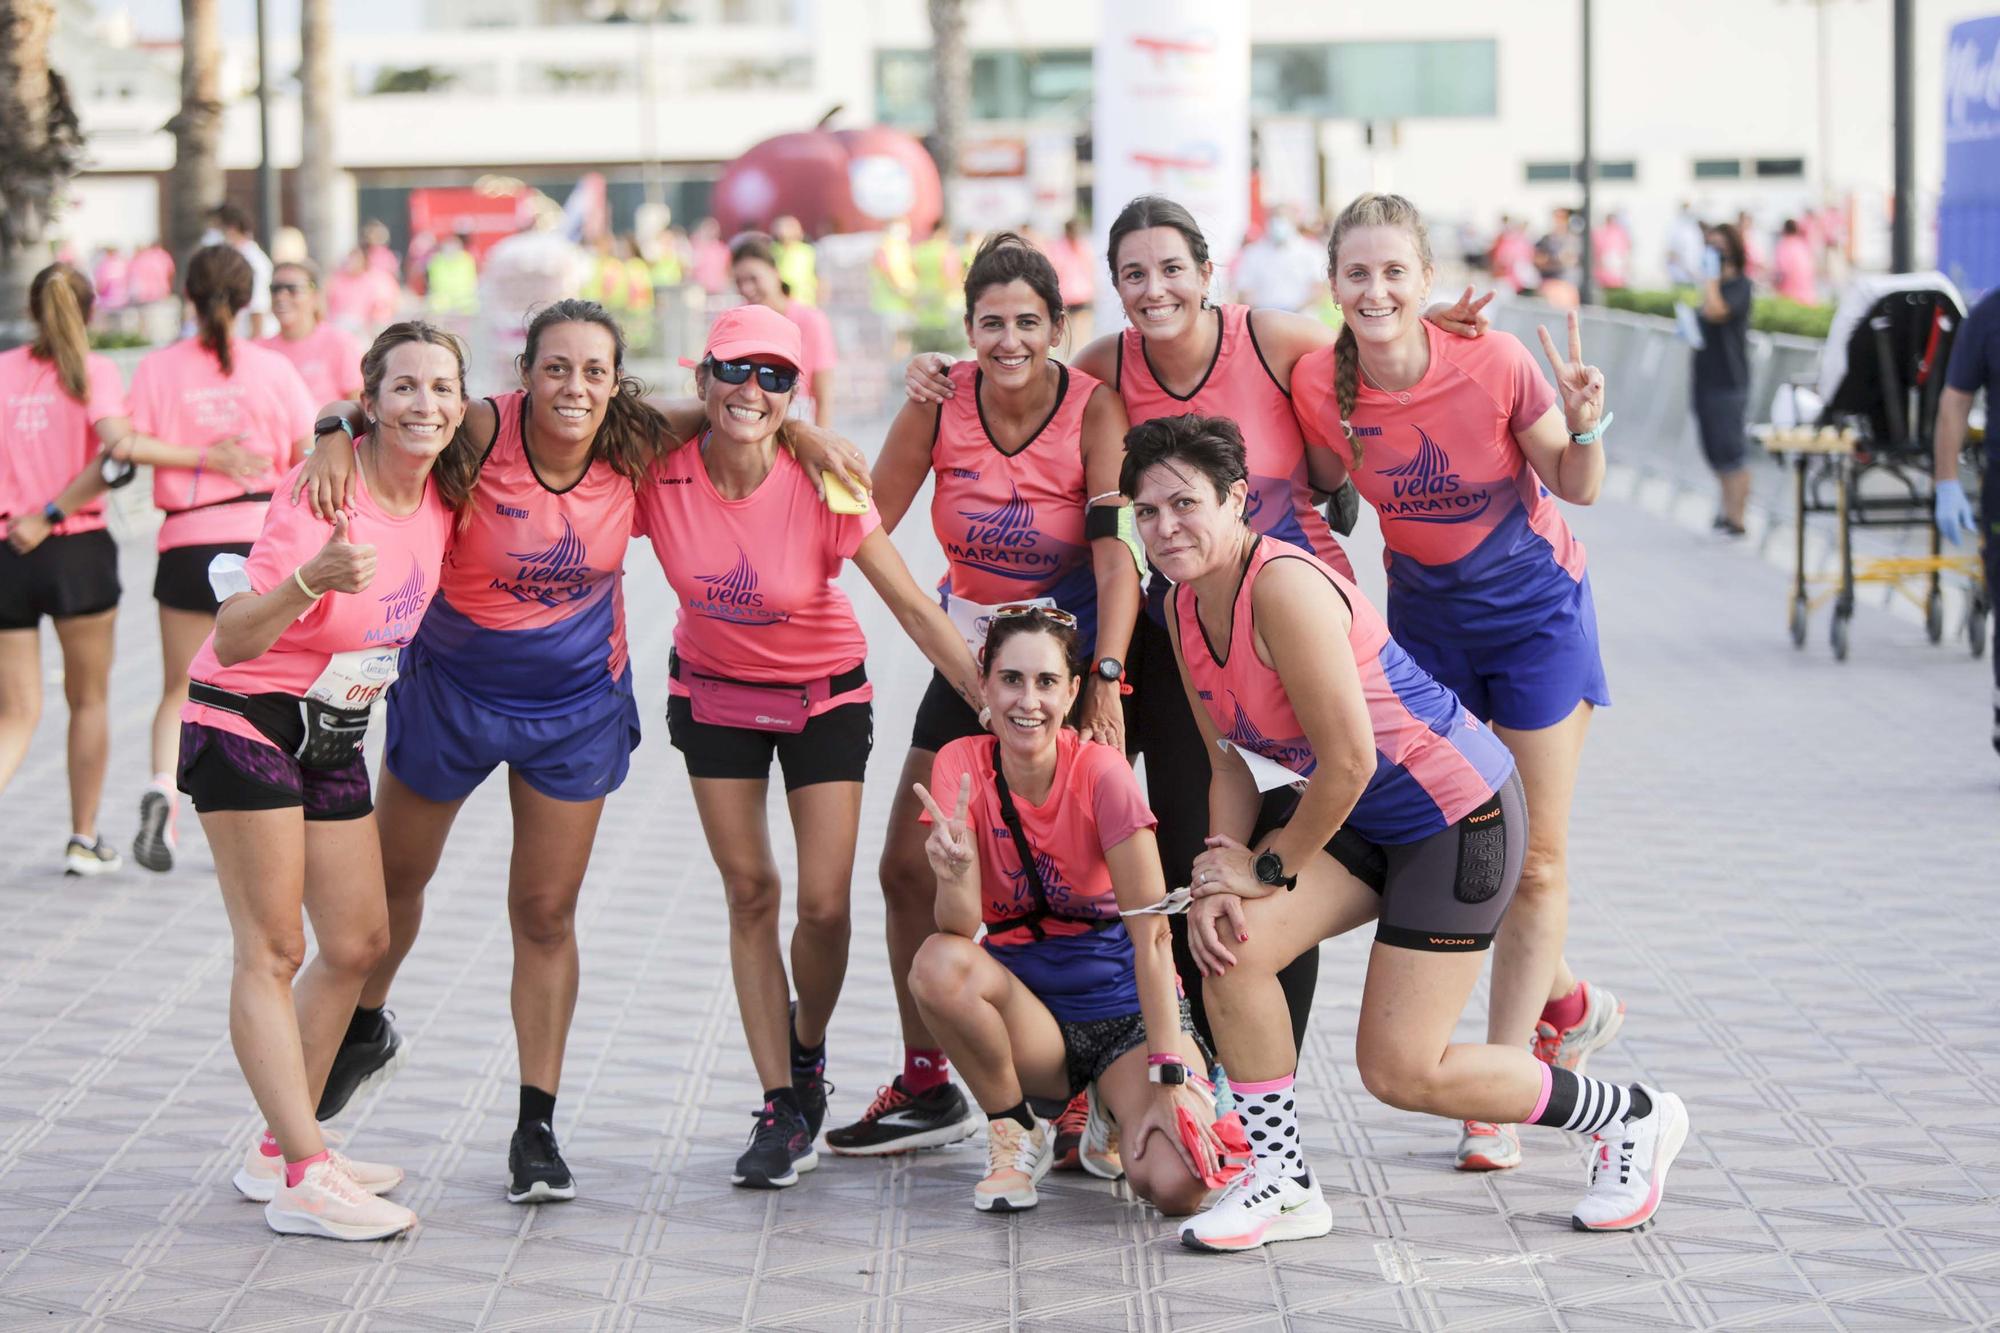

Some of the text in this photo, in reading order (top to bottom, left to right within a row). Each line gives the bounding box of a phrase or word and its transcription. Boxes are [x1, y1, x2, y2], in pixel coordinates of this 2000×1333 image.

[1393, 475, 1460, 498] velas
[1379, 489, 1487, 514] MARATON
[965, 525, 1040, 549] velas
[947, 542, 1060, 566] MARATON
[516, 566, 592, 585] velas
[385, 591, 427, 624] velas
[689, 599, 787, 617] MARATON
[707, 586, 764, 607] velas
[1468, 808, 1501, 823] WONG
